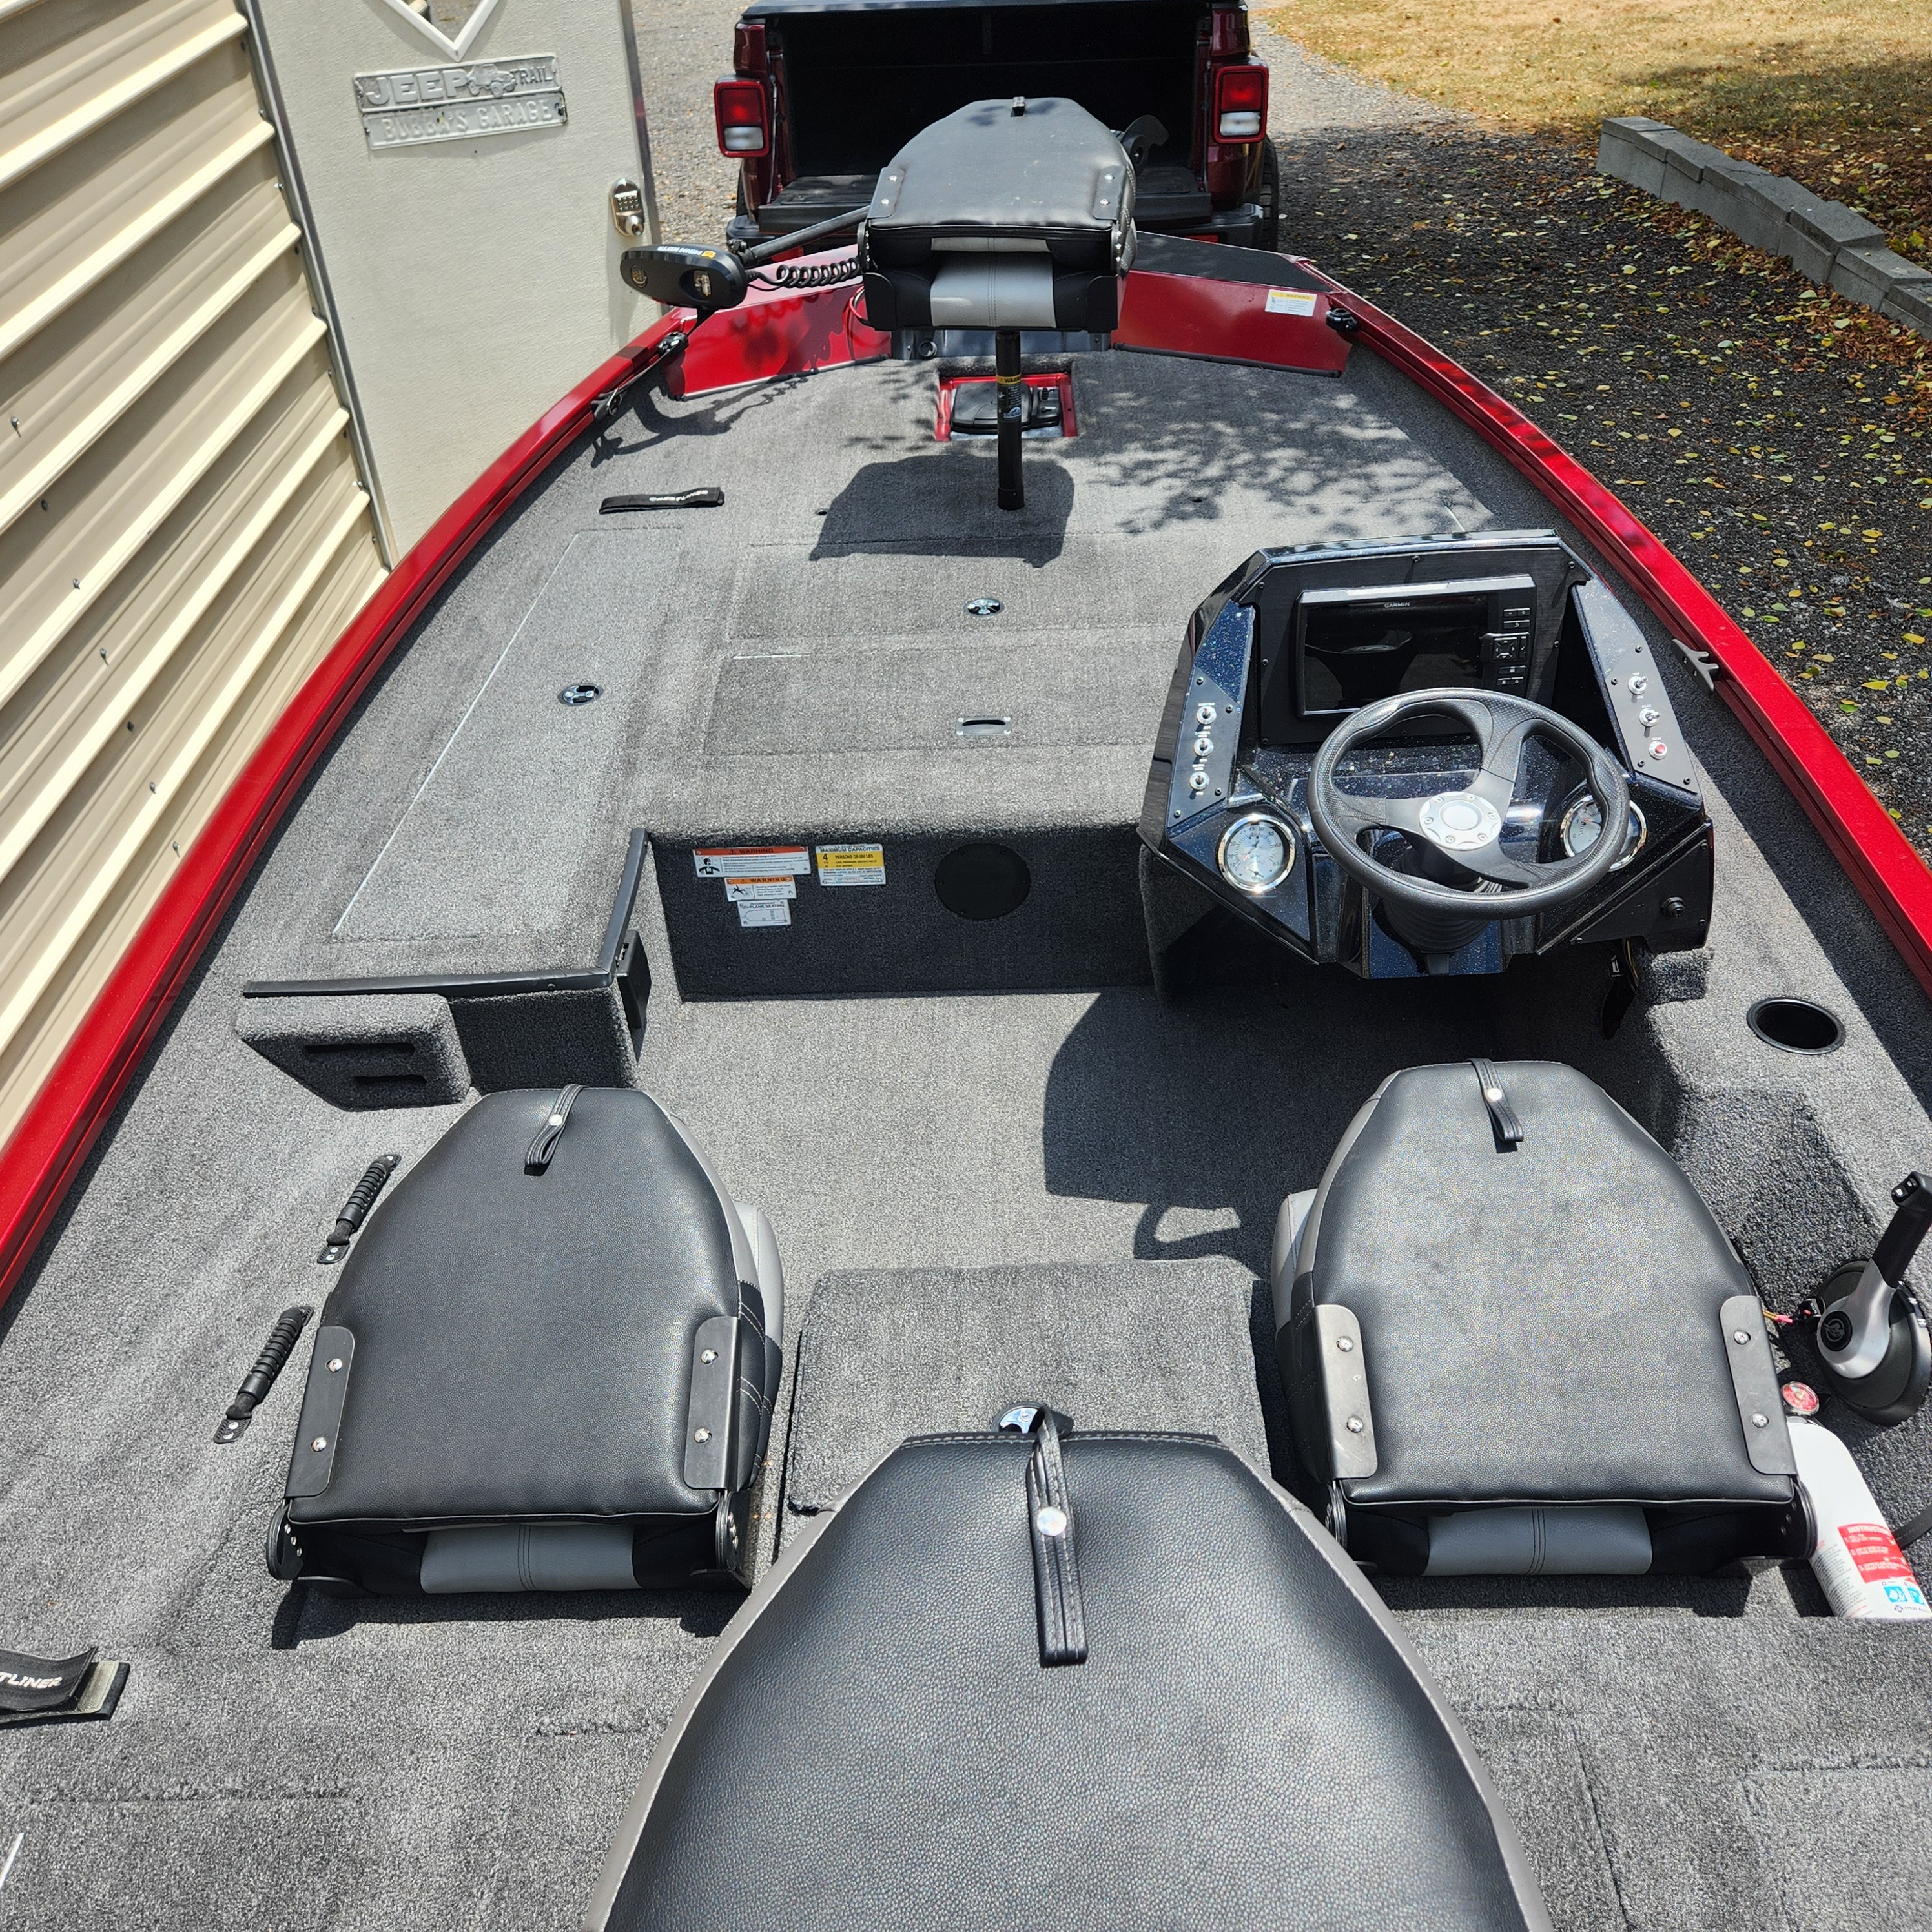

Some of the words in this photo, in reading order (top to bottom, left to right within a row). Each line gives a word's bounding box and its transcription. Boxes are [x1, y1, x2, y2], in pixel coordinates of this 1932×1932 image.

[365, 68, 468, 106] JEEP
[509, 65, 554, 87] TRAIL
[477, 99, 552, 129] GARAGE
